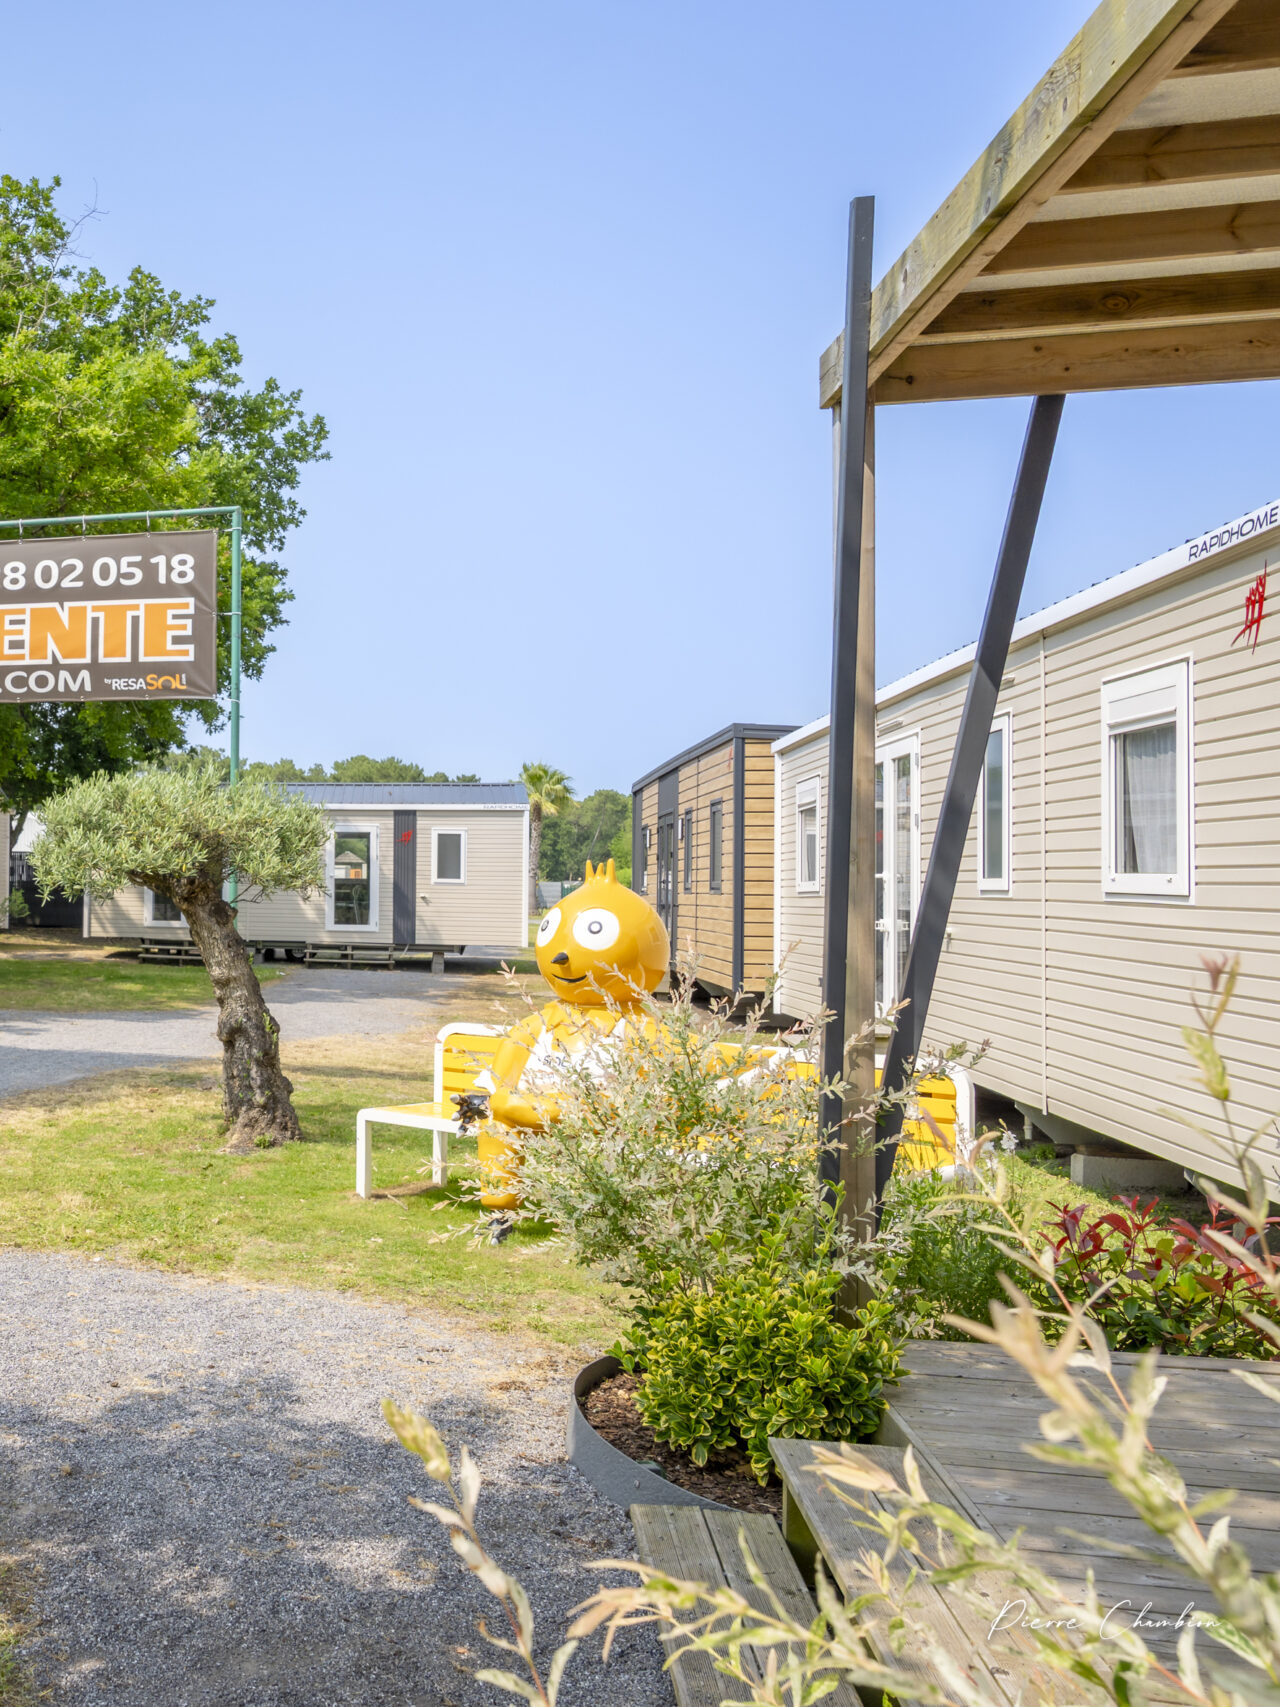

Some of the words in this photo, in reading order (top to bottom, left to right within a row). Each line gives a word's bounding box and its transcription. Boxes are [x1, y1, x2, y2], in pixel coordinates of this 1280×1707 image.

[1188, 505, 1279, 562] RAPIDHOME
[34, 558, 84, 589] 02
[92, 555, 143, 587] 05
[150, 553, 195, 585] 18
